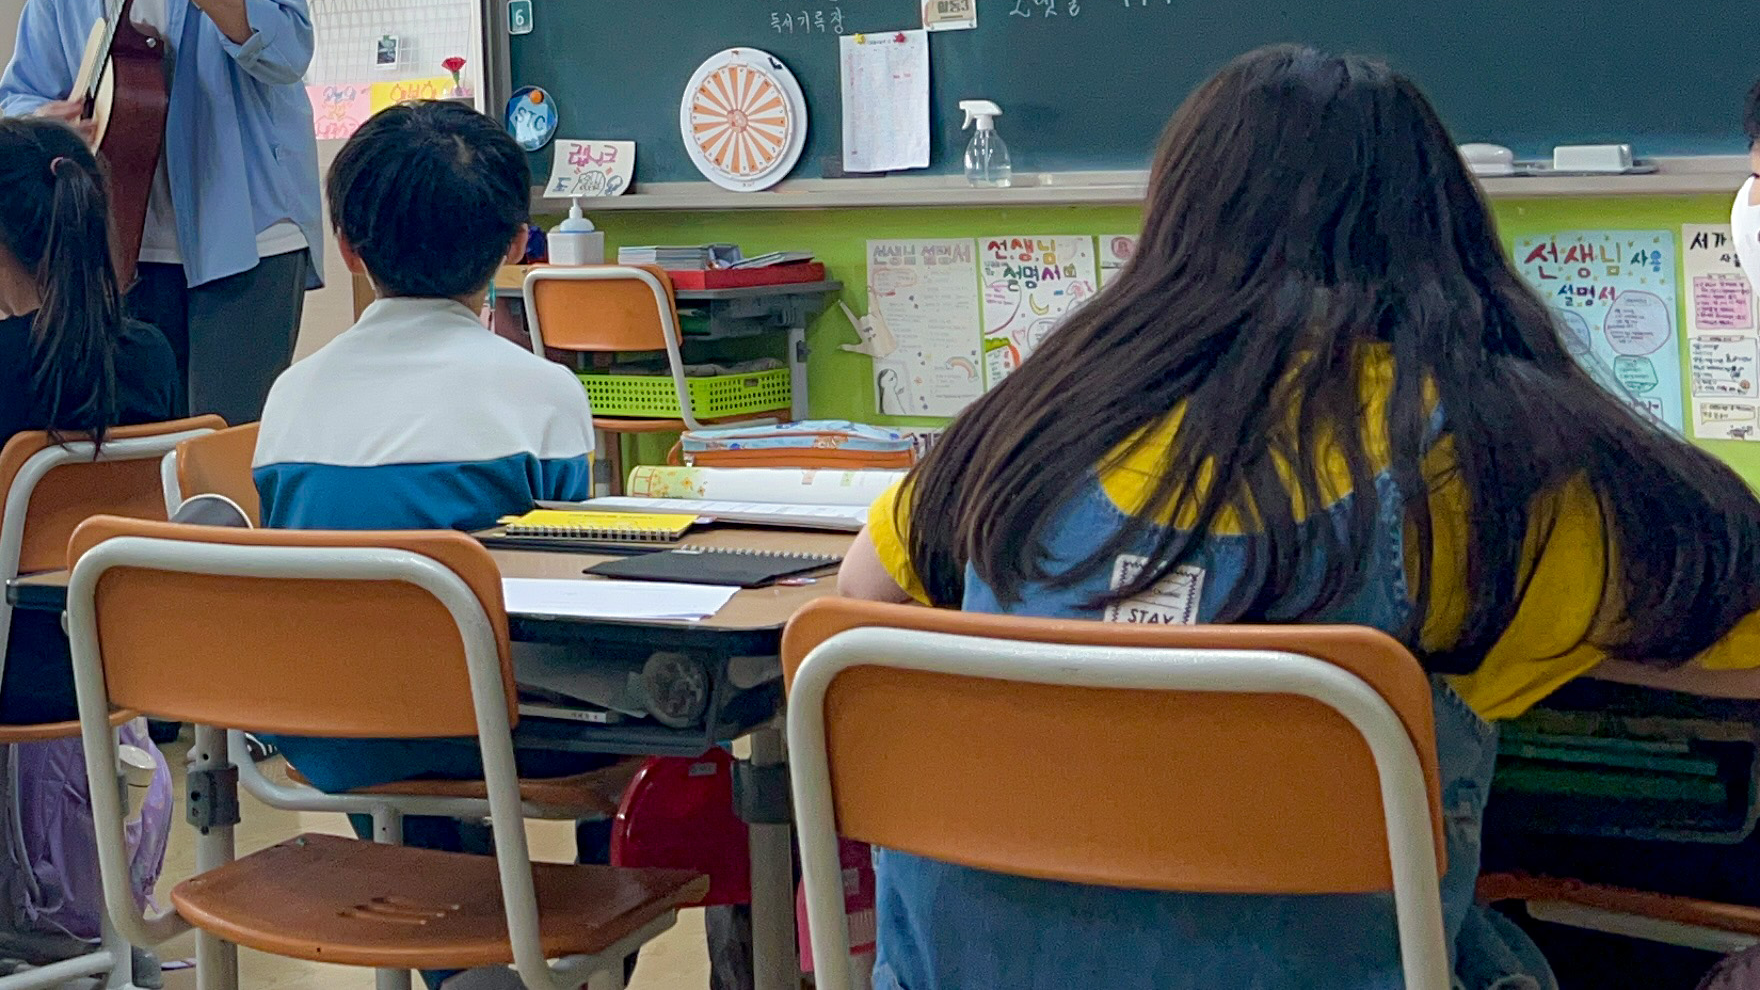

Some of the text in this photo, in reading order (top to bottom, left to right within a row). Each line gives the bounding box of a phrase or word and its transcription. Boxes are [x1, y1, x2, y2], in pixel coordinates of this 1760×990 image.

[515, 9, 524, 26] 6
[1523, 241, 1661, 280] 선생님 사용
[1557, 284, 1617, 307] 설명서
